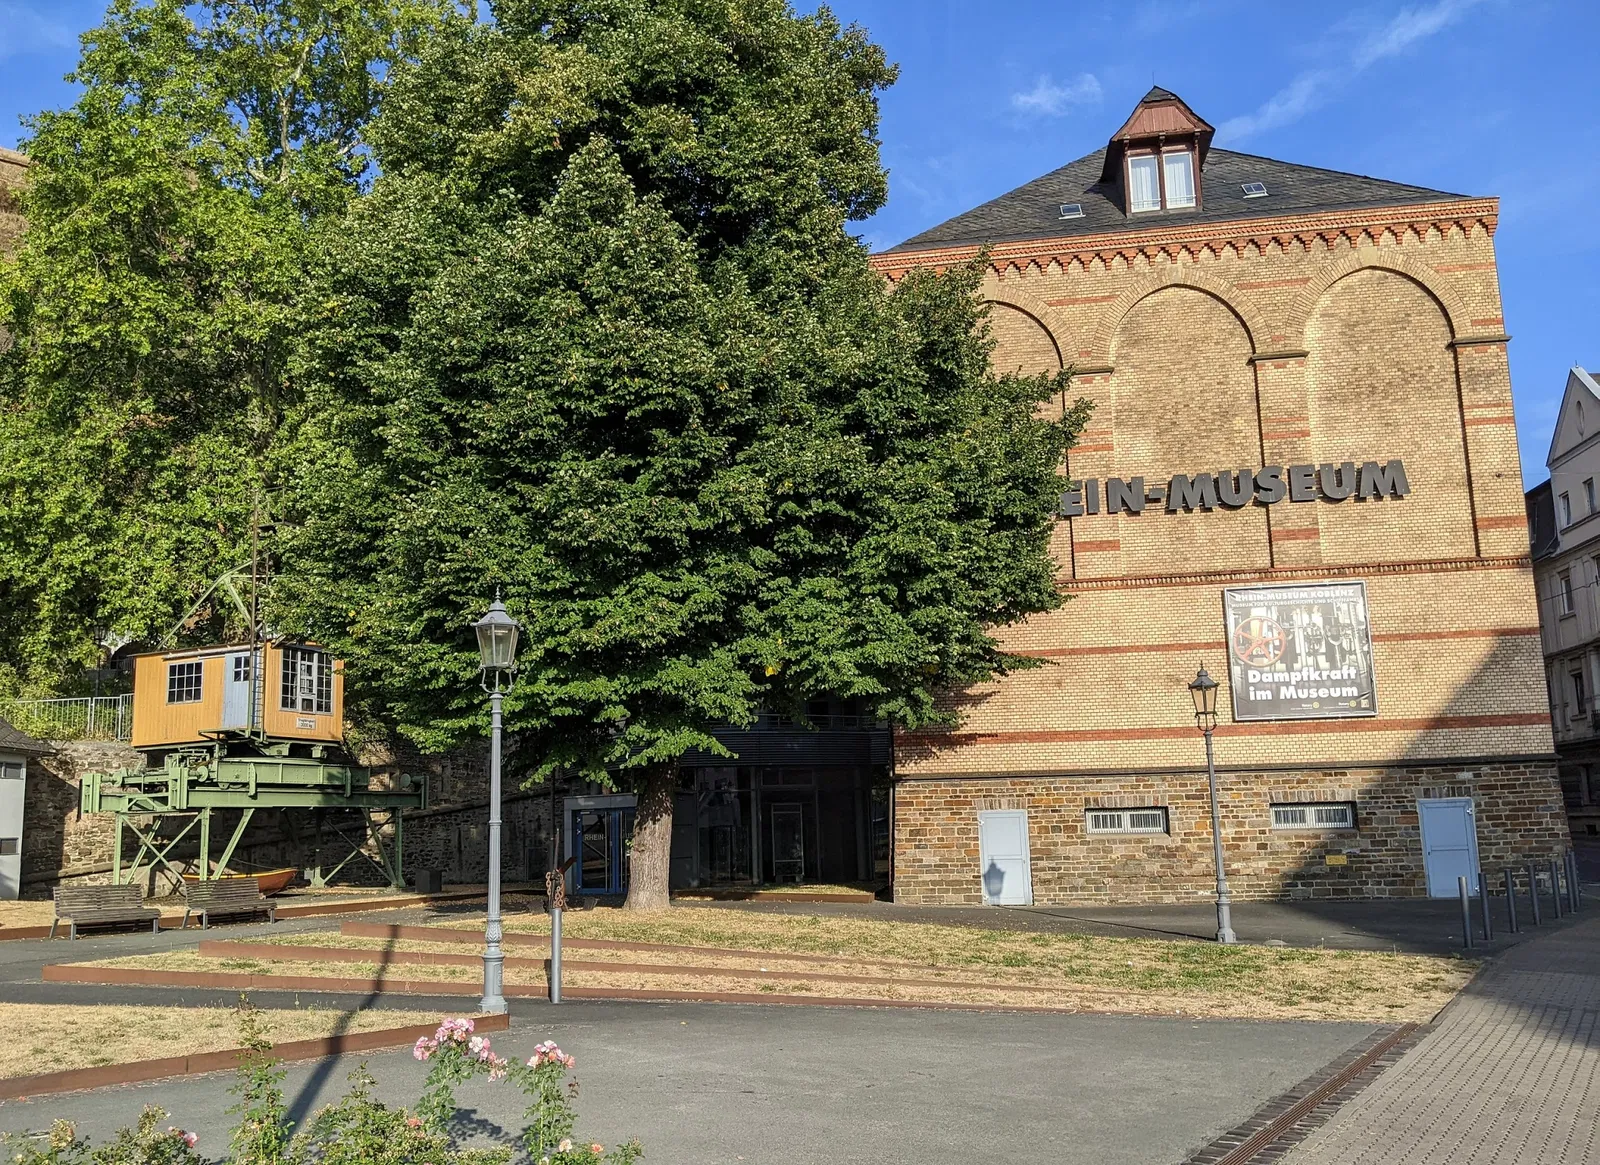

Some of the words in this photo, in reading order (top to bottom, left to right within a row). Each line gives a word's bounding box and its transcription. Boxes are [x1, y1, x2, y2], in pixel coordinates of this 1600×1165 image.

[1236, 592, 1309, 602] RHEIN-MUSEUM
[1311, 589, 1354, 598] KOBLENZ
[1247, 665, 1357, 685] Dampfkraft
[1249, 686, 1273, 700] im
[1279, 686, 1358, 699] Museum
